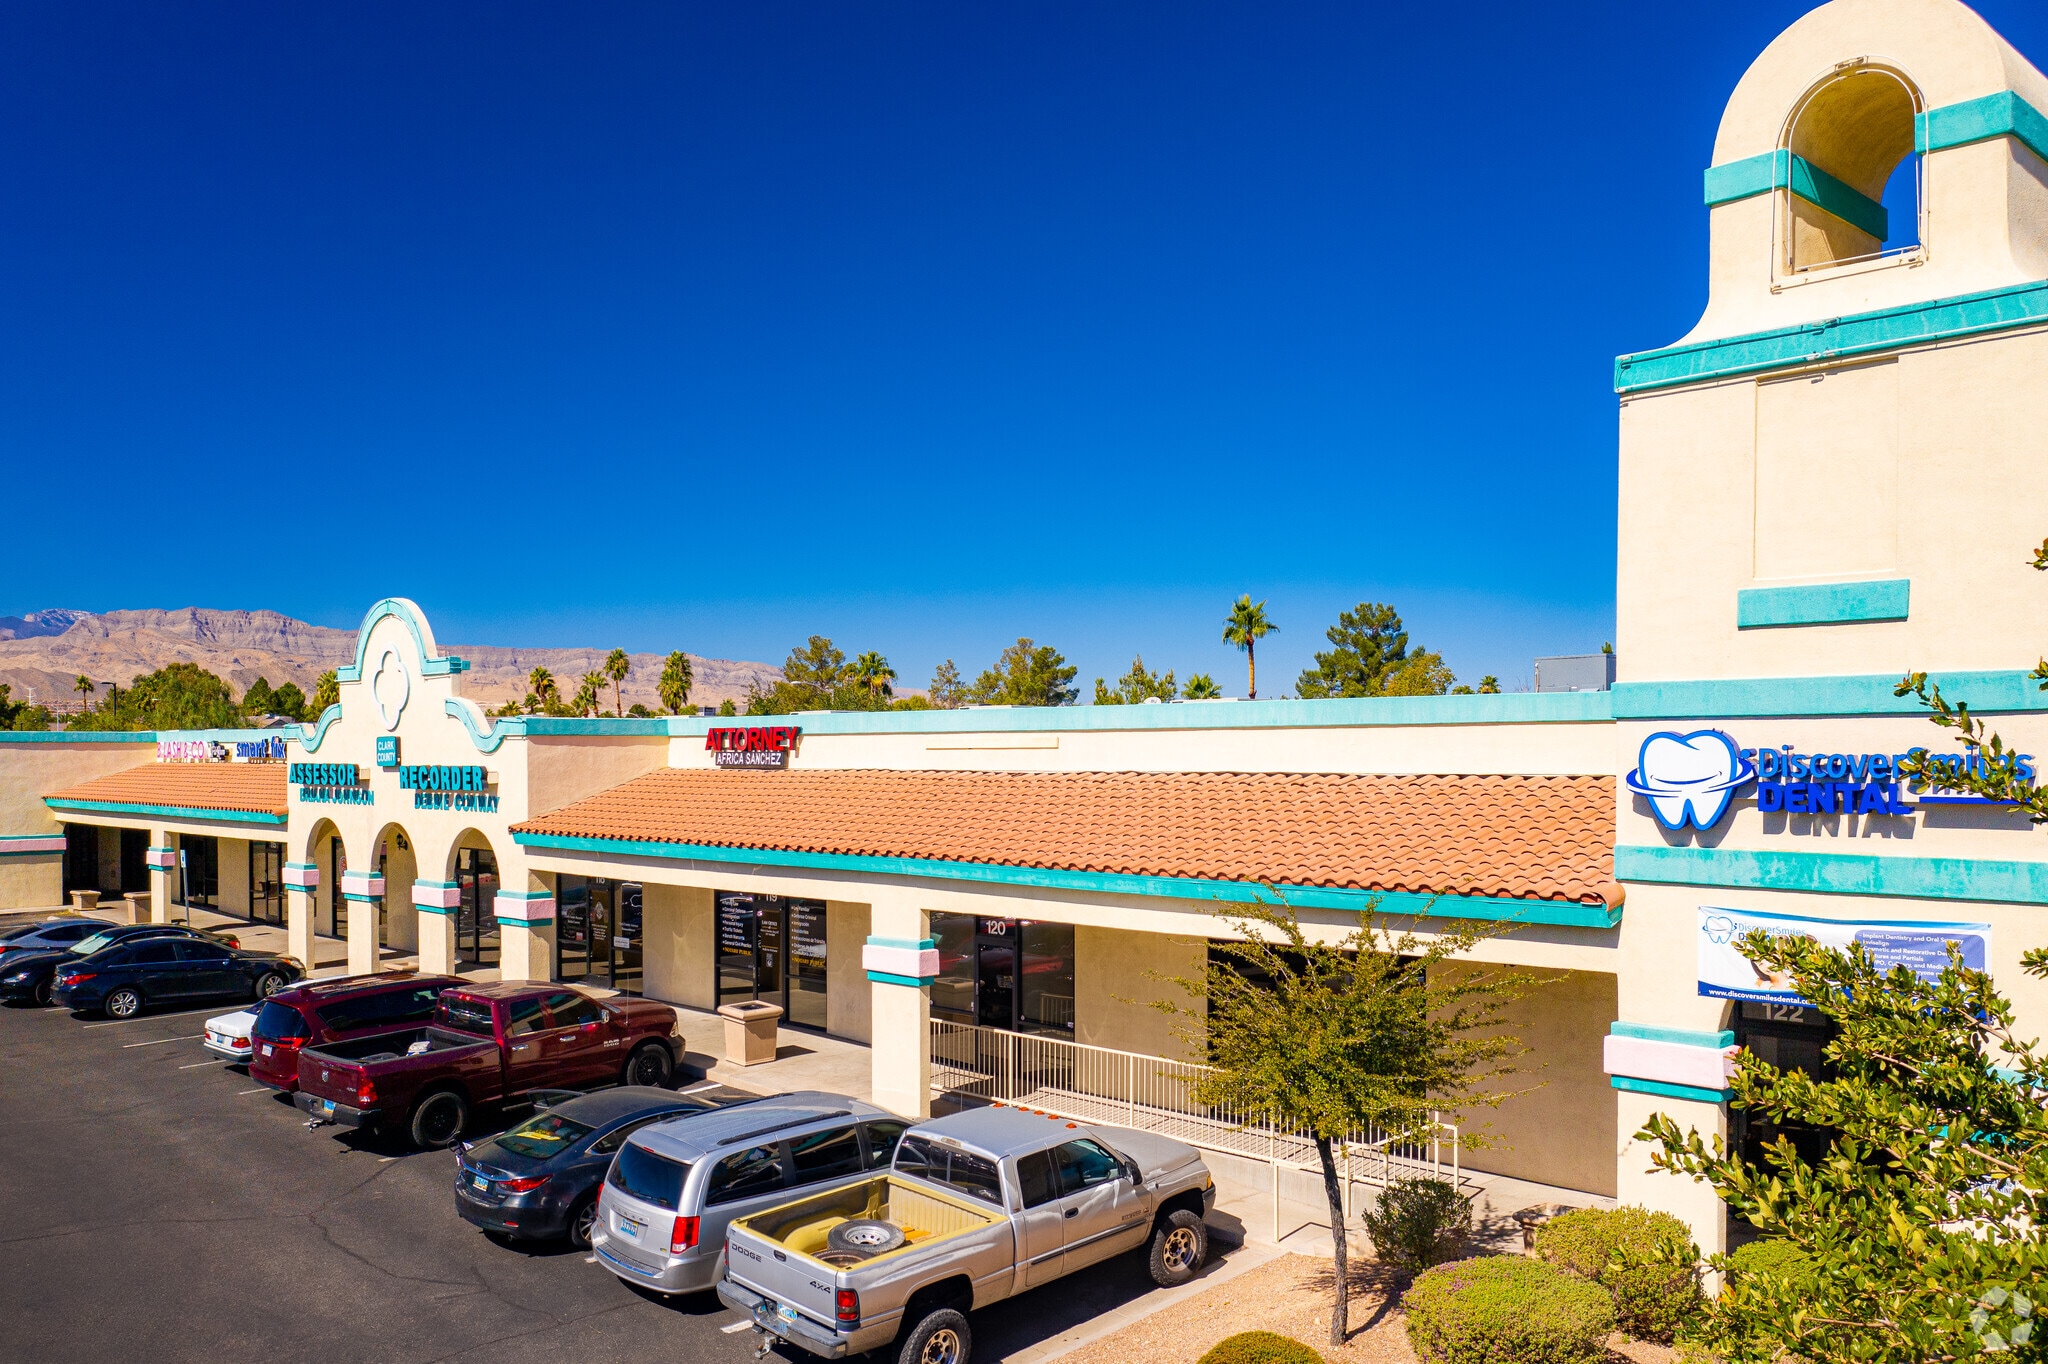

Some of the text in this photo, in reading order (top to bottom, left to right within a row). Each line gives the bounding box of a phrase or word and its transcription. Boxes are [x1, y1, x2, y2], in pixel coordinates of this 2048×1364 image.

[236, 735, 285, 759] smart fix
[377, 740, 395, 751] CLARK
[705, 726, 797, 751] ATTORNEY
[377, 752, 396, 762] COUNTY
[716, 752, 781, 765] AFRICA SANCHEZ
[289, 763, 356, 786] ASSESSOR
[399, 765, 484, 791] RECORDER
[454, 793, 500, 813] CONWAY
[1756, 782, 1914, 815] DENTAL
[986, 920, 1006, 935] 120
[1862, 932, 1885, 940] Implant
[1886, 934, 1912, 942] Dentistry
[1708, 988, 1817, 1005] www.discoversmilesdental.co
[1762, 1003, 1804, 1023] 122
[731, 1243, 762, 1263] DODGE
